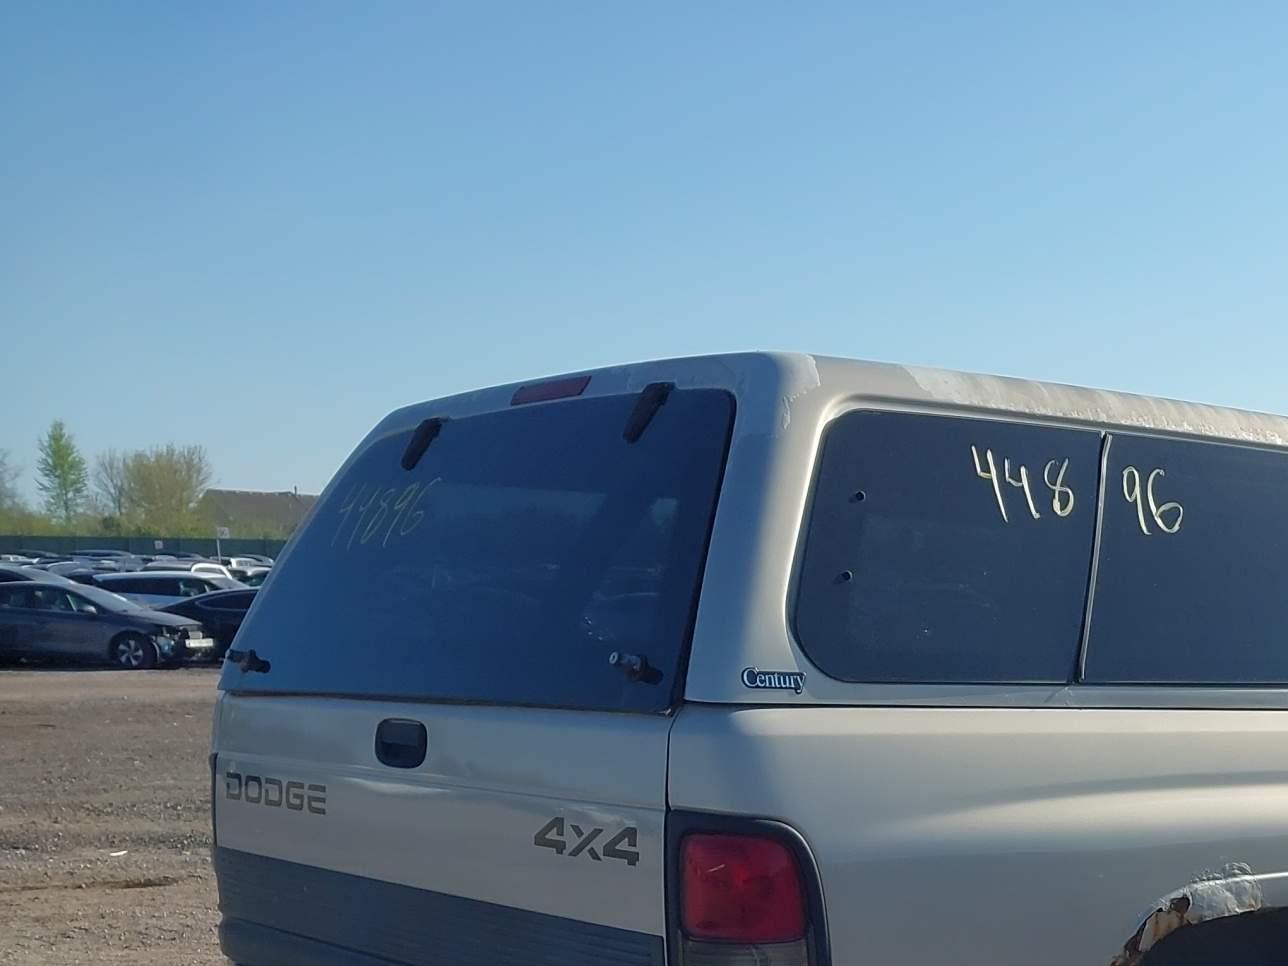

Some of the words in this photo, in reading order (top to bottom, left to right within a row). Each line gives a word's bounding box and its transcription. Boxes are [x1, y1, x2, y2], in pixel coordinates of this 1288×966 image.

[970, 445, 1074, 523] 448
[1122, 466, 1184, 535] 96
[743, 667, 806, 693] Century
[225, 772, 327, 815] DODGE
